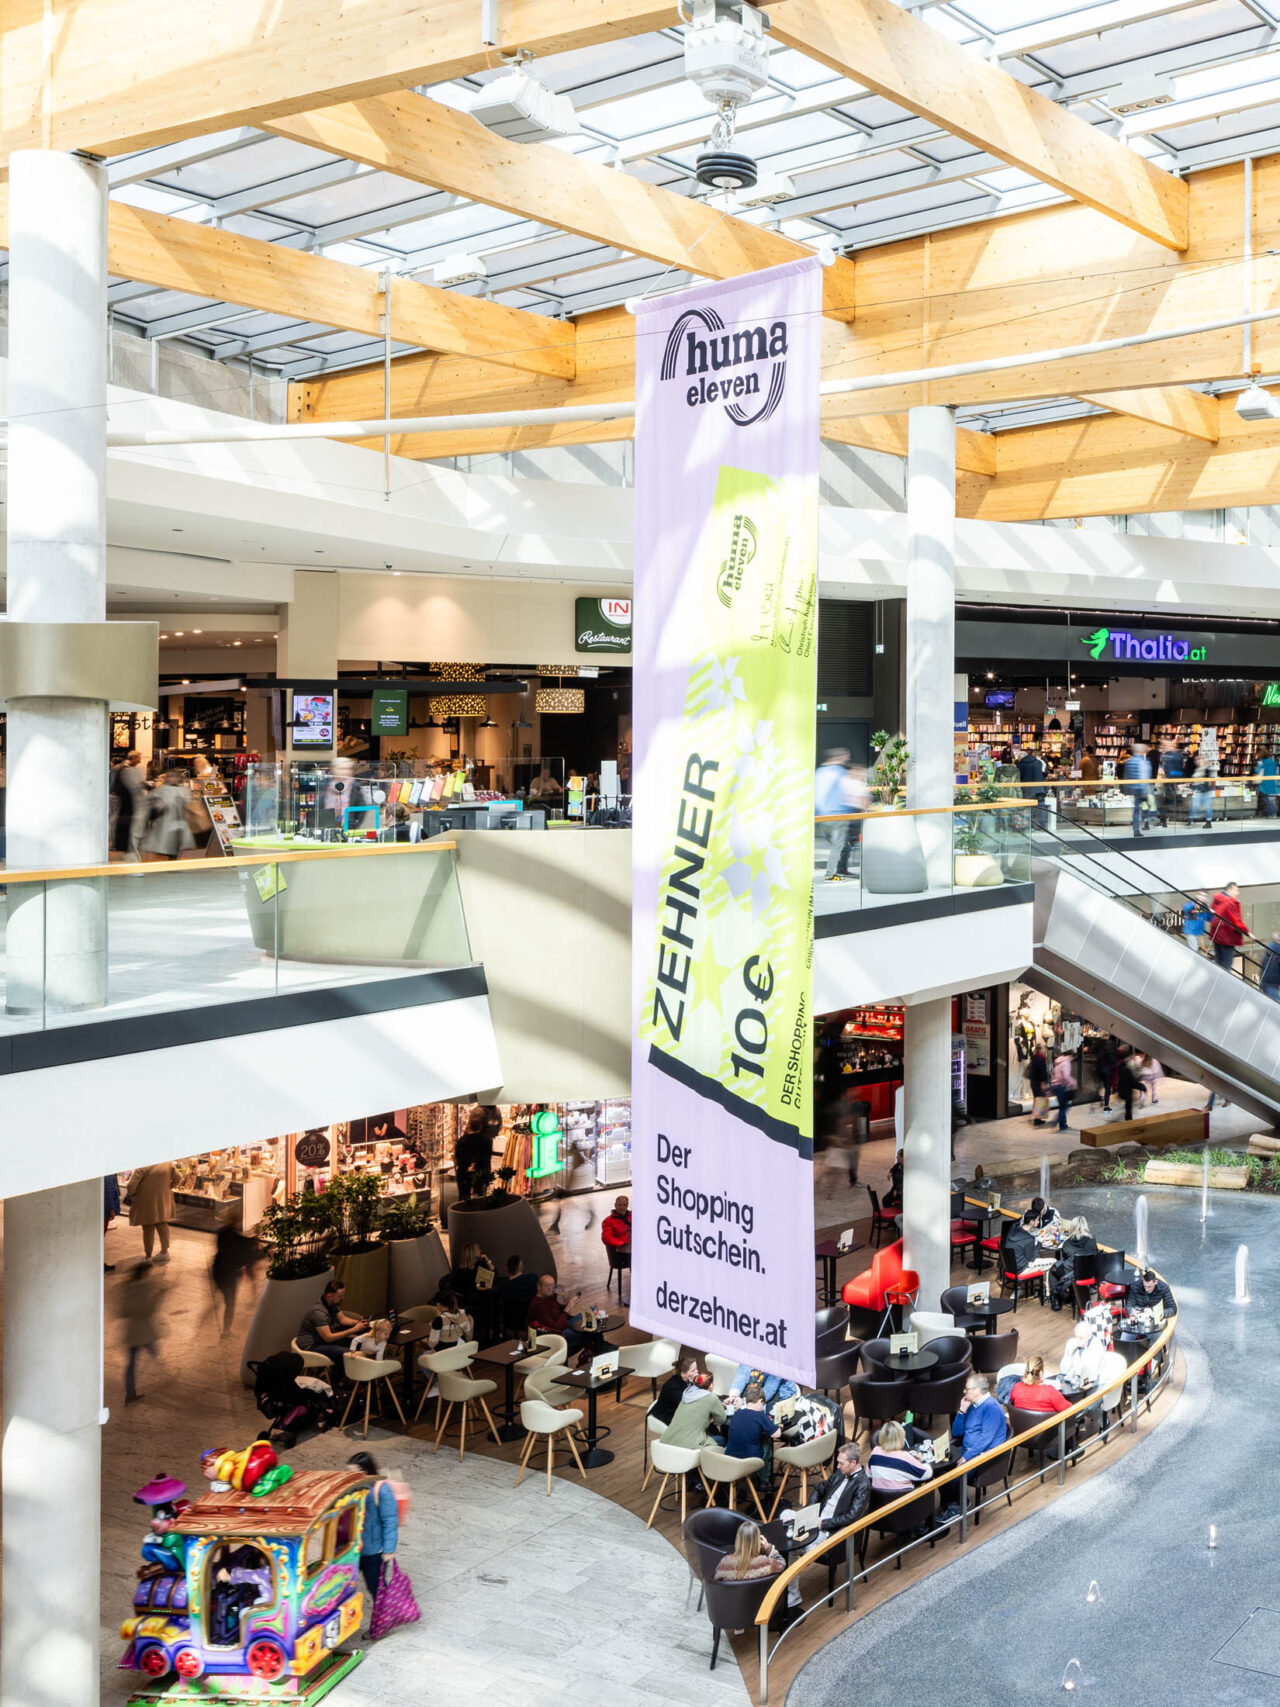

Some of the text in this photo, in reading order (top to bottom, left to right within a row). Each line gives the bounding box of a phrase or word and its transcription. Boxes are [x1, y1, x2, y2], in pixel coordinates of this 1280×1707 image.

[686, 321, 788, 375] huma
[687, 372, 760, 407] eleven
[722, 515, 743, 588] huma
[735, 538, 749, 591] eleven
[578, 630, 631, 646] Restaurant
[654, 752, 720, 1042] ZEHNER
[780, 1073, 796, 1106] DER
[300, 1143, 326, 1158] 20%
[657, 1133, 692, 1169] Der
[656, 1174, 754, 1234] Shopping
[656, 1215, 766, 1275] Gutschein.
[656, 1280, 788, 1349] derzehner.at
